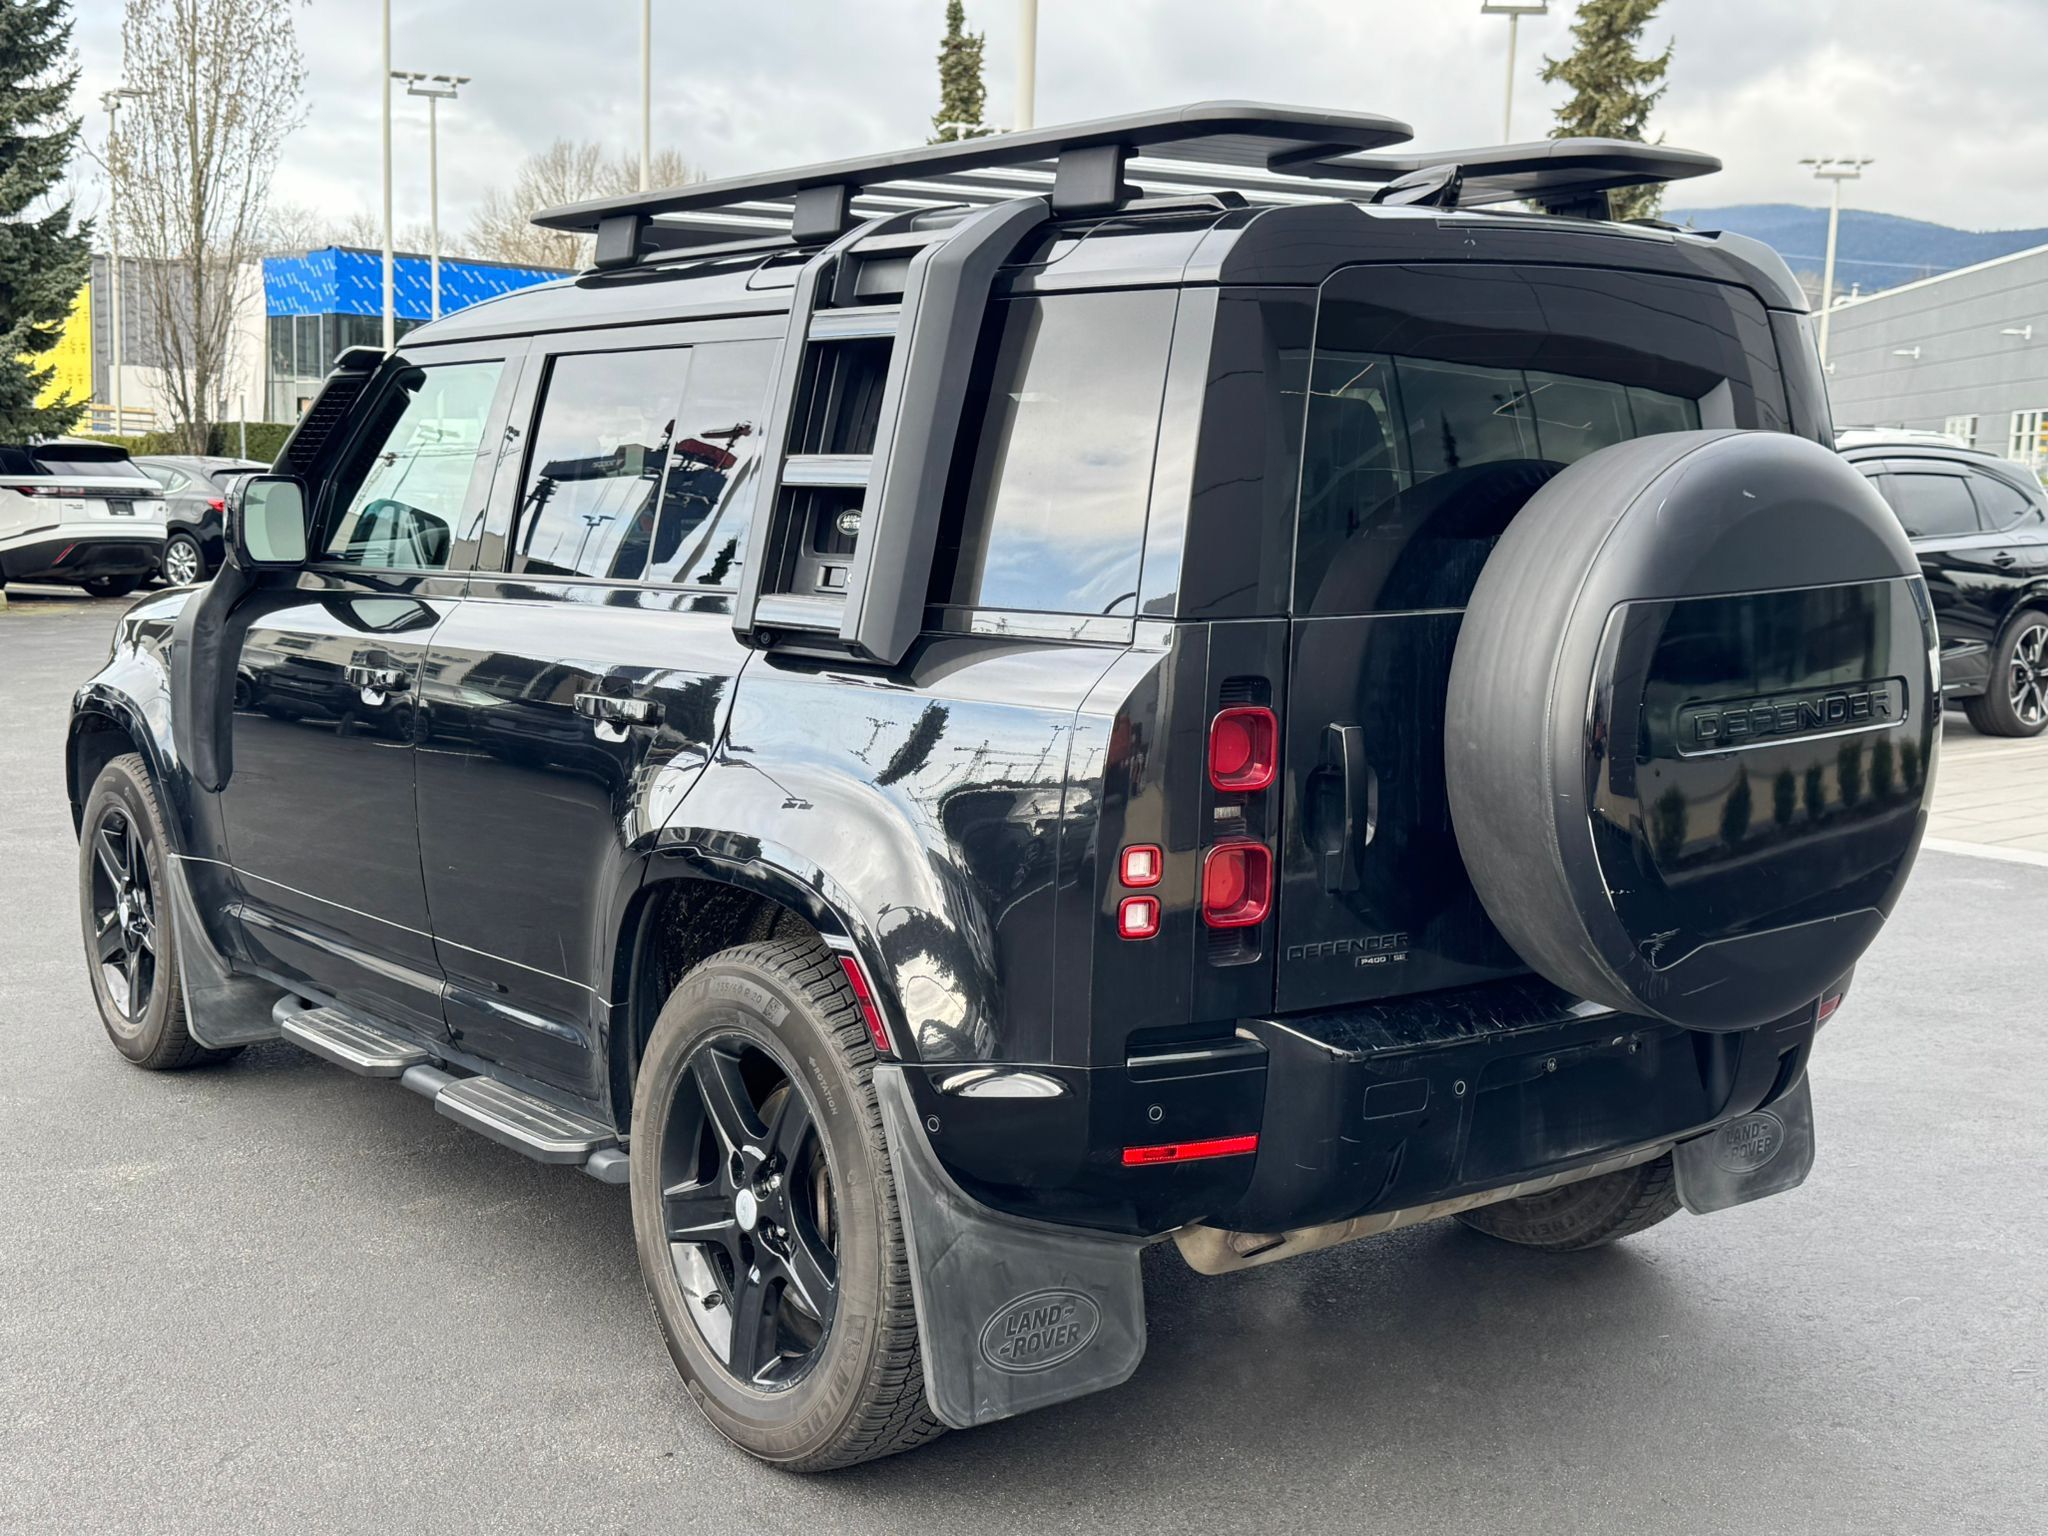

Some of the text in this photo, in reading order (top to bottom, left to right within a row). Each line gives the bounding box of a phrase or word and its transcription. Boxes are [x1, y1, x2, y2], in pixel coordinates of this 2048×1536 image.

[1694, 689, 1891, 741] DEFENDER
[1287, 932, 1408, 961] DEFENDER
[1360, 956, 1386, 966] P400
[813, 1067, 838, 1115] ROTATION
[1726, 1122, 1760, 1144] LAND
[1731, 1137, 1771, 1159] ROVER
[1006, 1304, 1062, 1337] LAND
[1011, 1323, 1080, 1358] ROVER
